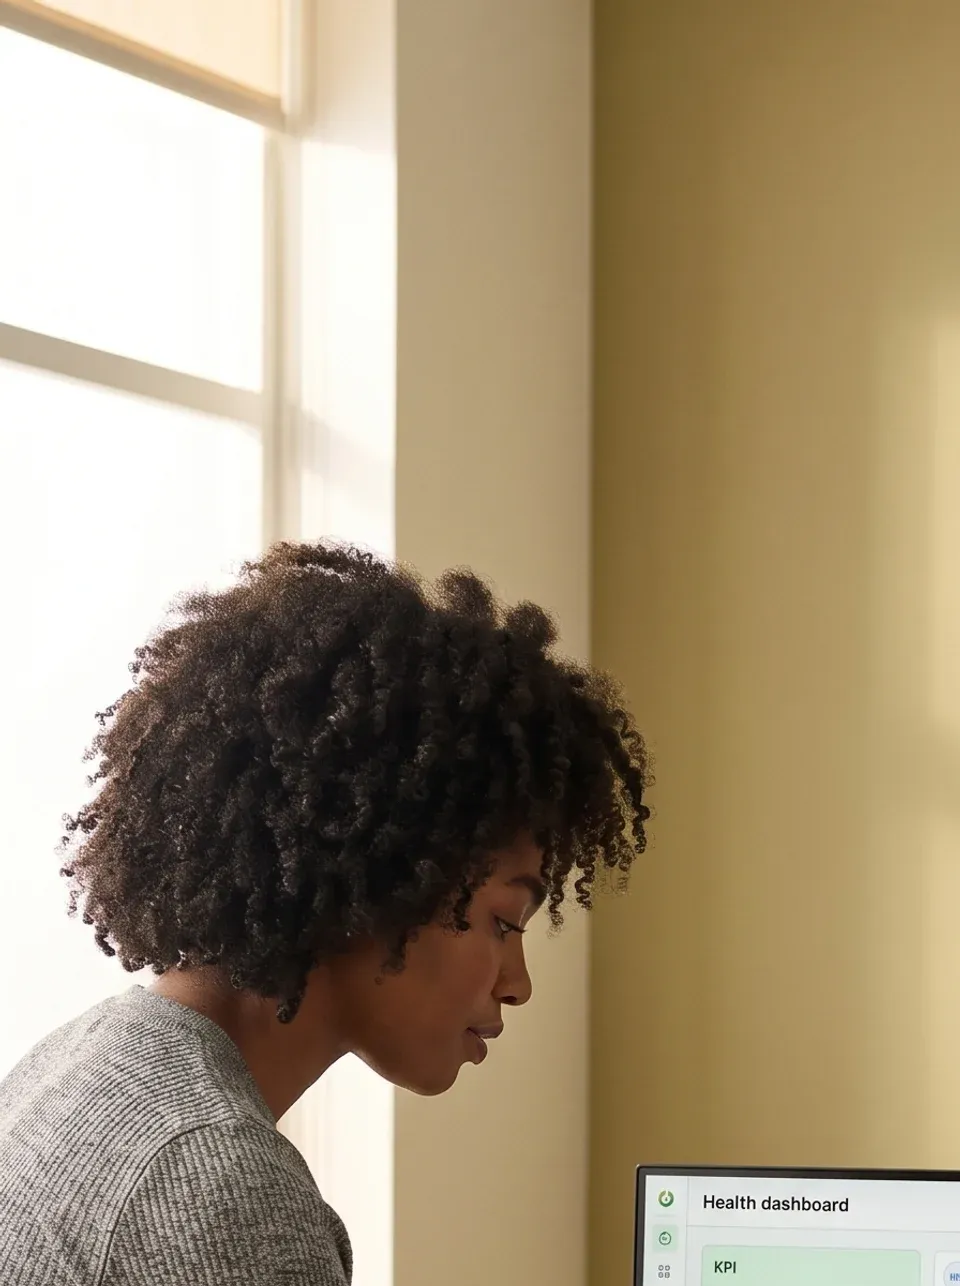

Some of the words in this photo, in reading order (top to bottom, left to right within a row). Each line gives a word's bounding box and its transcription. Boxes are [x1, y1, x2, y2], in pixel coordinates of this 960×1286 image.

[703, 1194, 757, 1210] Health
[761, 1195, 850, 1213] dashboard
[714, 1260, 738, 1275] KPI
